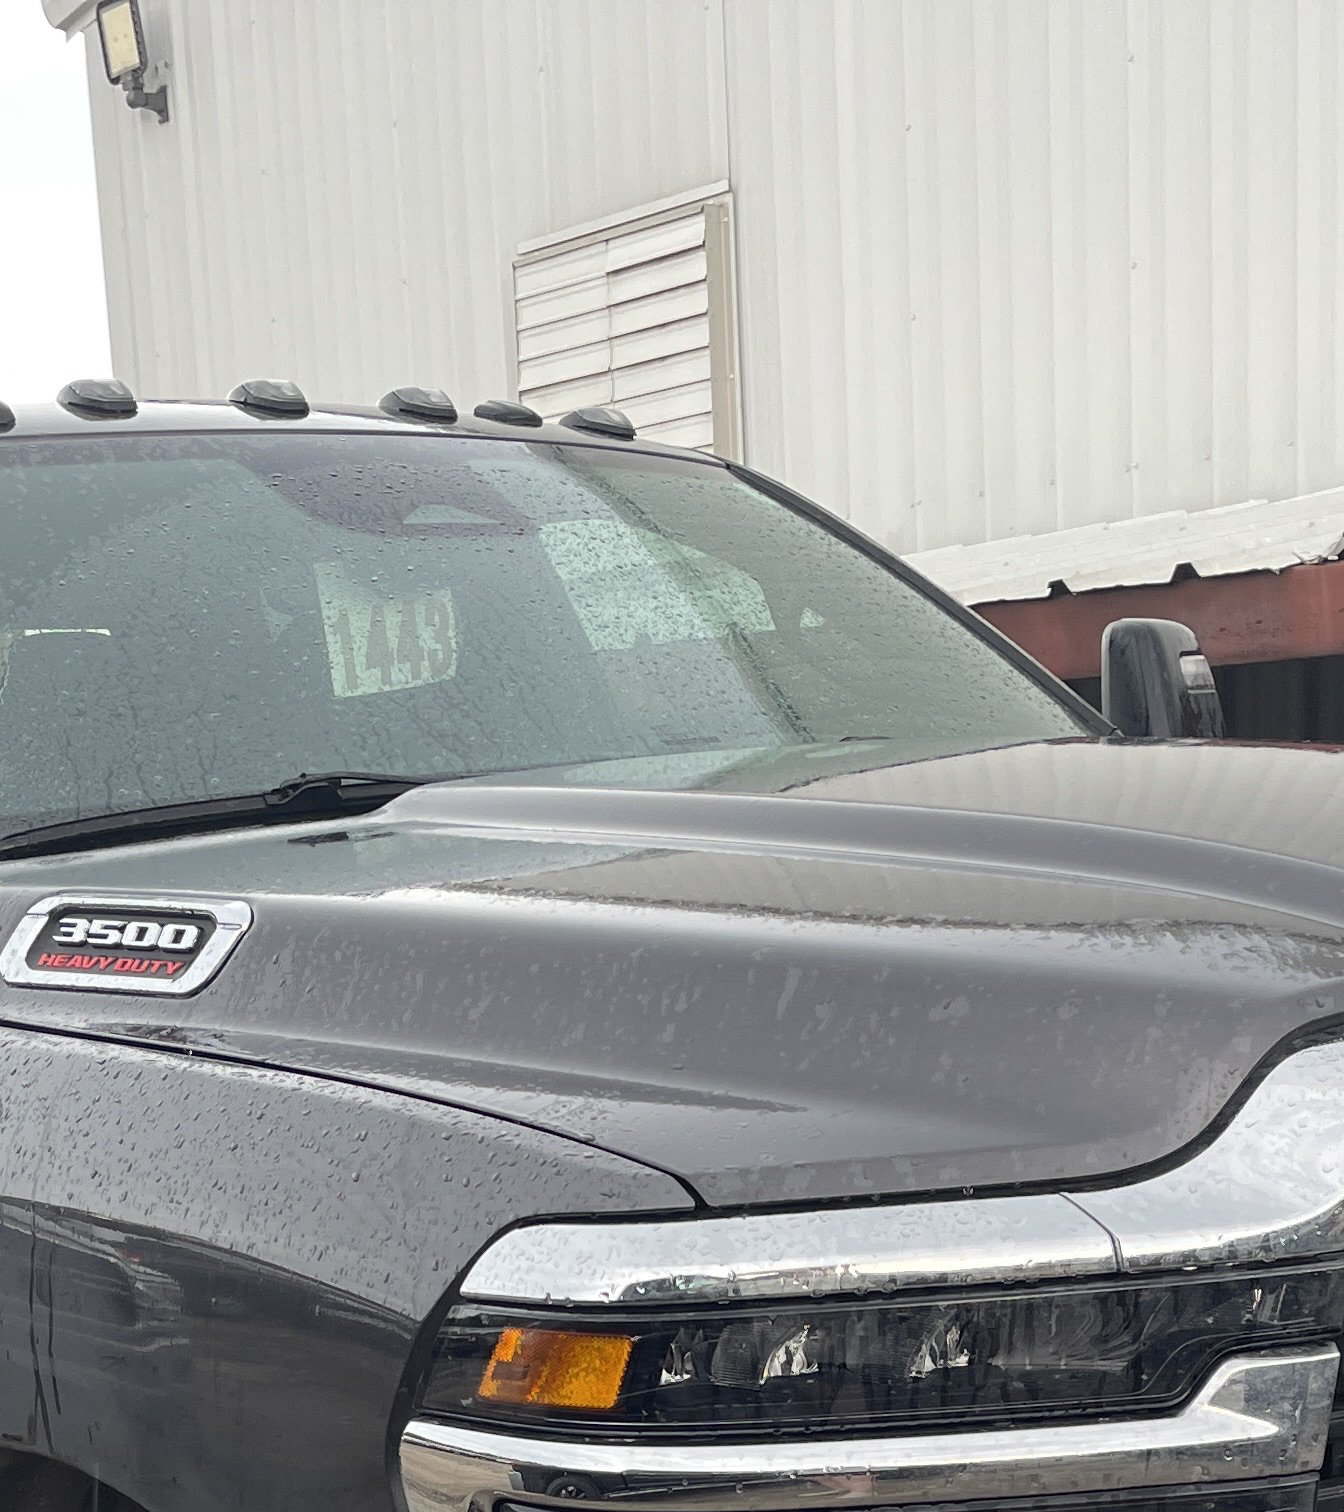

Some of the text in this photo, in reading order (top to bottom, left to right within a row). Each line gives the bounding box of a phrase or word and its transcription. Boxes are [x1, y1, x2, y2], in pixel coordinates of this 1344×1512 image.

[53, 917, 199, 950] 3500
[37, 953, 184, 975] HEAVY DUTY
